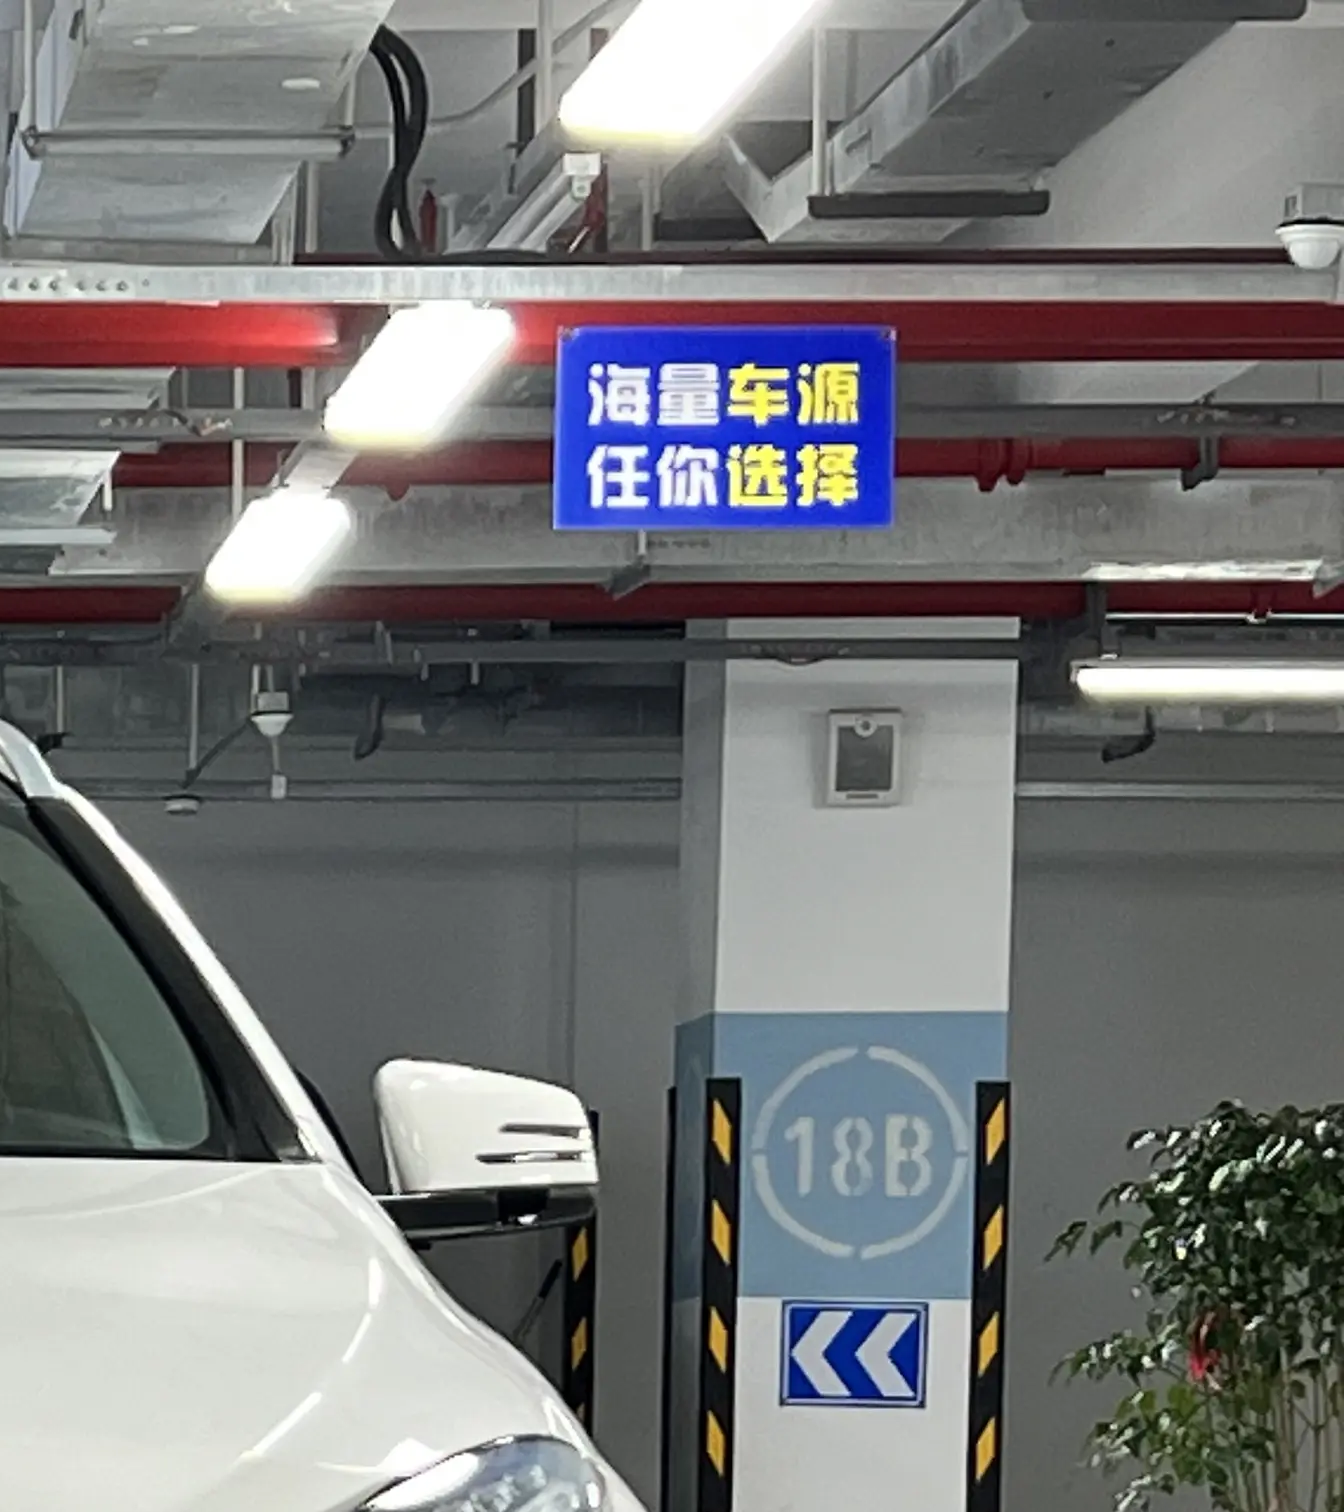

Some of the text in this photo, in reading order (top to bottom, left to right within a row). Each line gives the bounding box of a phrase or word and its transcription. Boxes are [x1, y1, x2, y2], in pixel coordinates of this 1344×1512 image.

[588, 362, 860, 427] 海量车源
[587, 444, 859, 508] 任你选择
[785, 1115, 933, 1198] 18B
